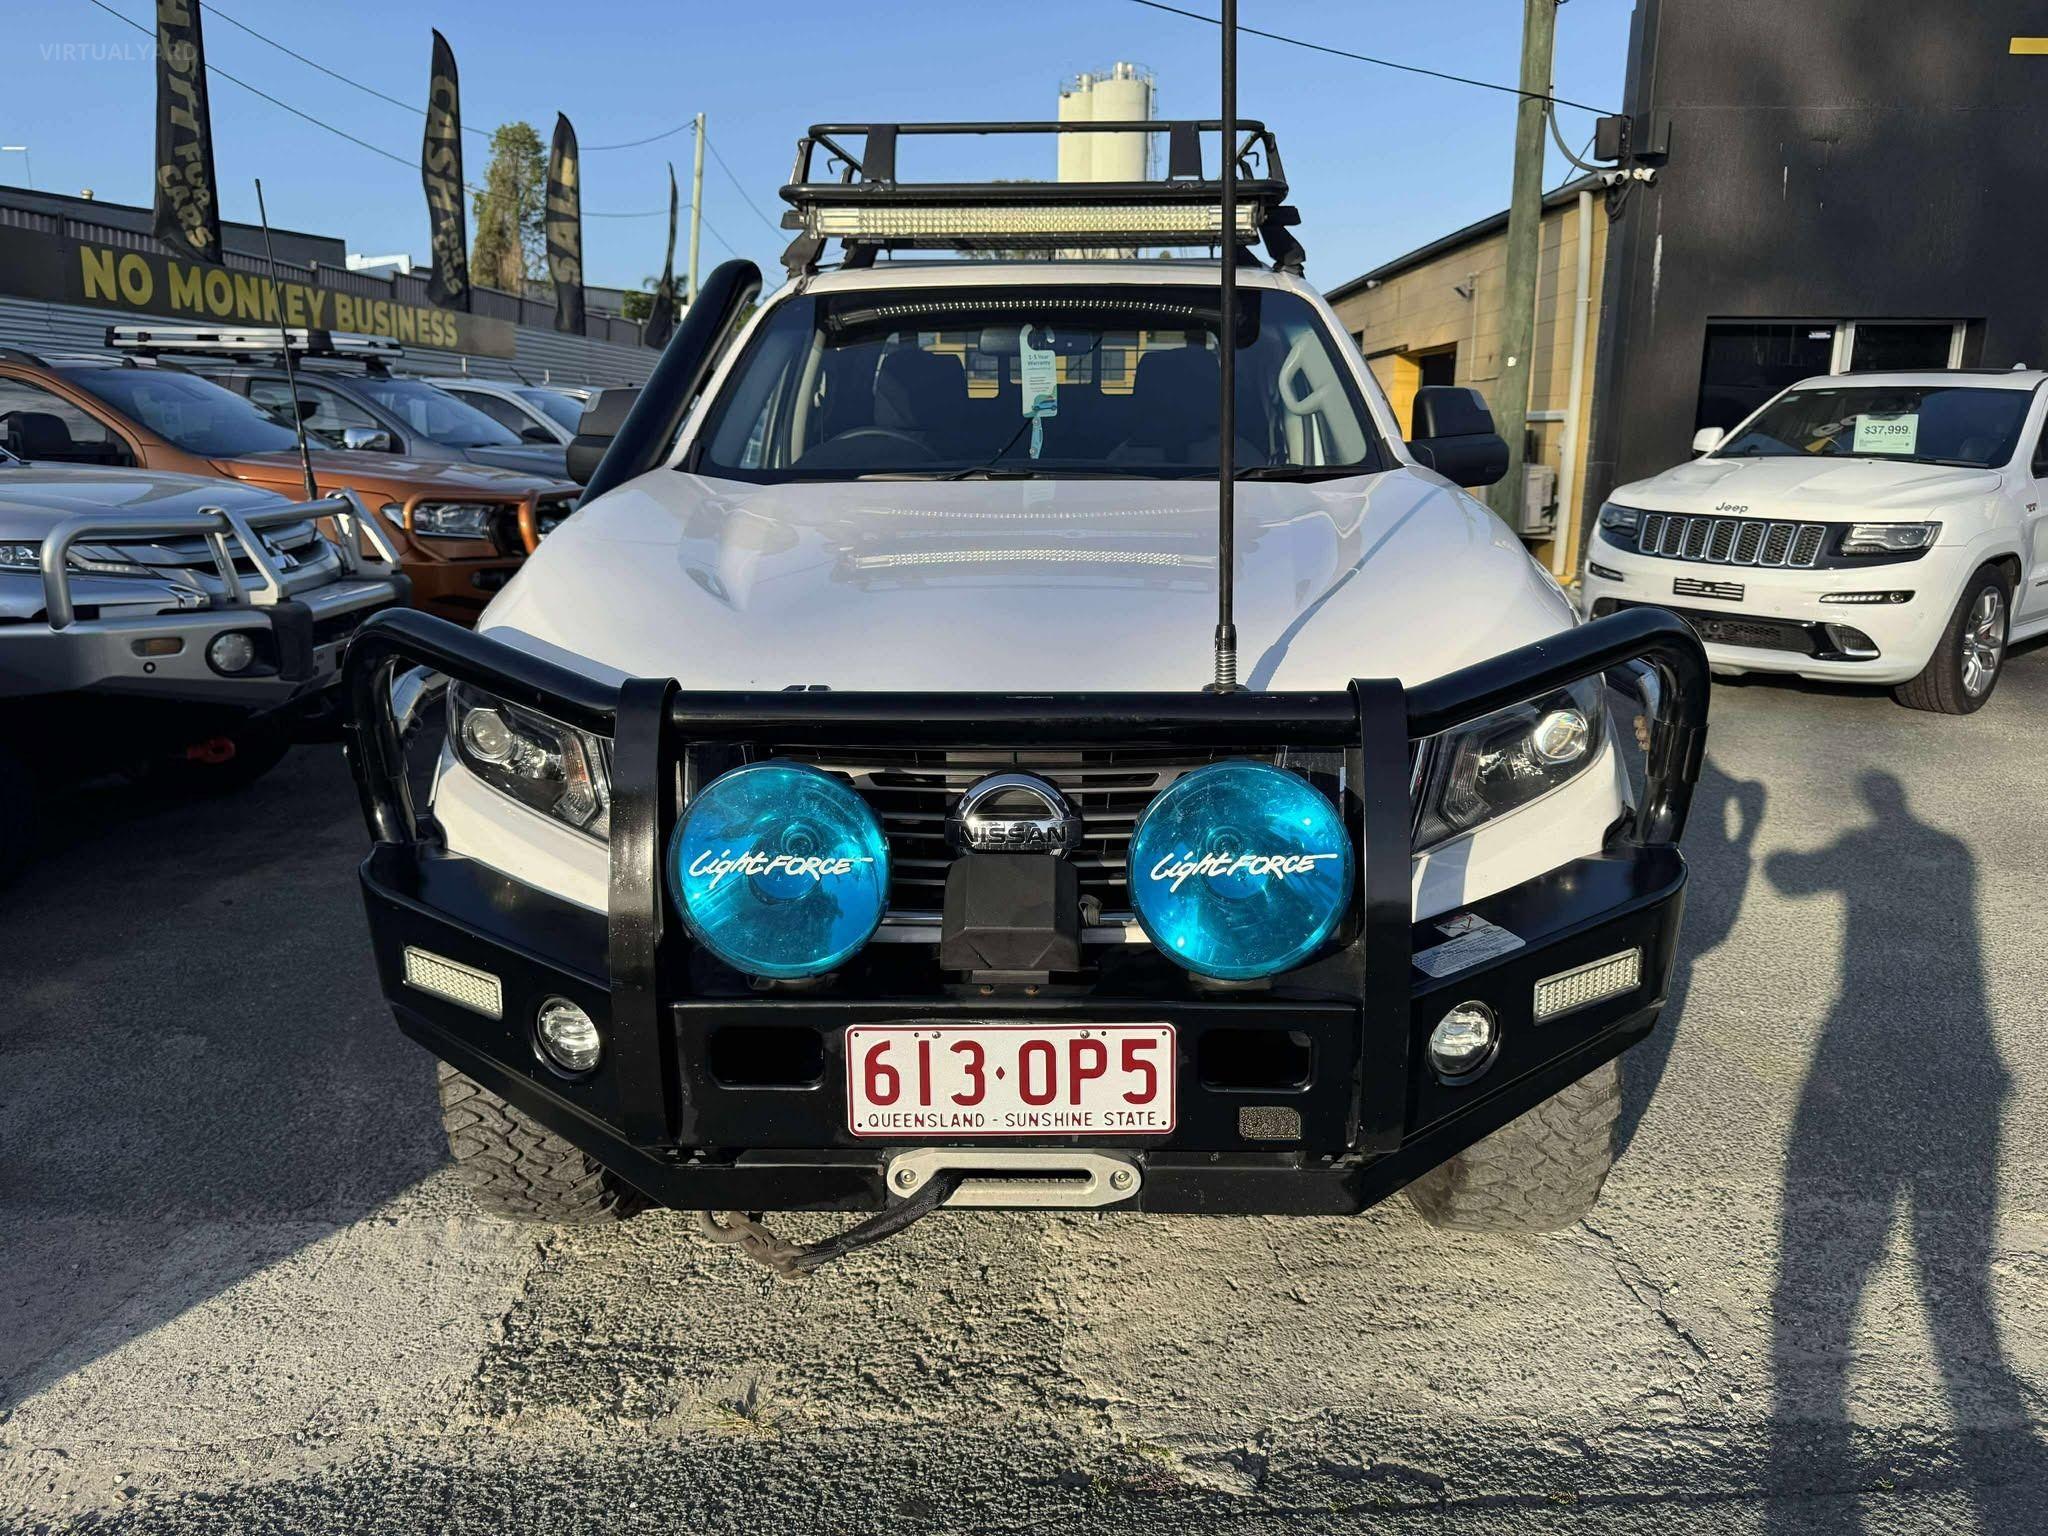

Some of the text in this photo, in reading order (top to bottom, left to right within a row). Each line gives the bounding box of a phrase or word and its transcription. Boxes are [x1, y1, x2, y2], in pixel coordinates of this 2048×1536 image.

[425, 75, 459, 216] CASH
[158, 165, 214, 248] CARS
[547, 149, 581, 287] SALE
[80, 245, 459, 348] NO MONKEY BUSINESS
[433, 234, 463, 295] CARS
[1715, 502, 1749, 514] Jeep
[959, 825, 1067, 844] NISSAN
[868, 1112, 985, 1128] QUEENSLAND
[1005, 1112, 1093, 1127] SUNSHINE
[1104, 1111, 1157, 1127] STATE
